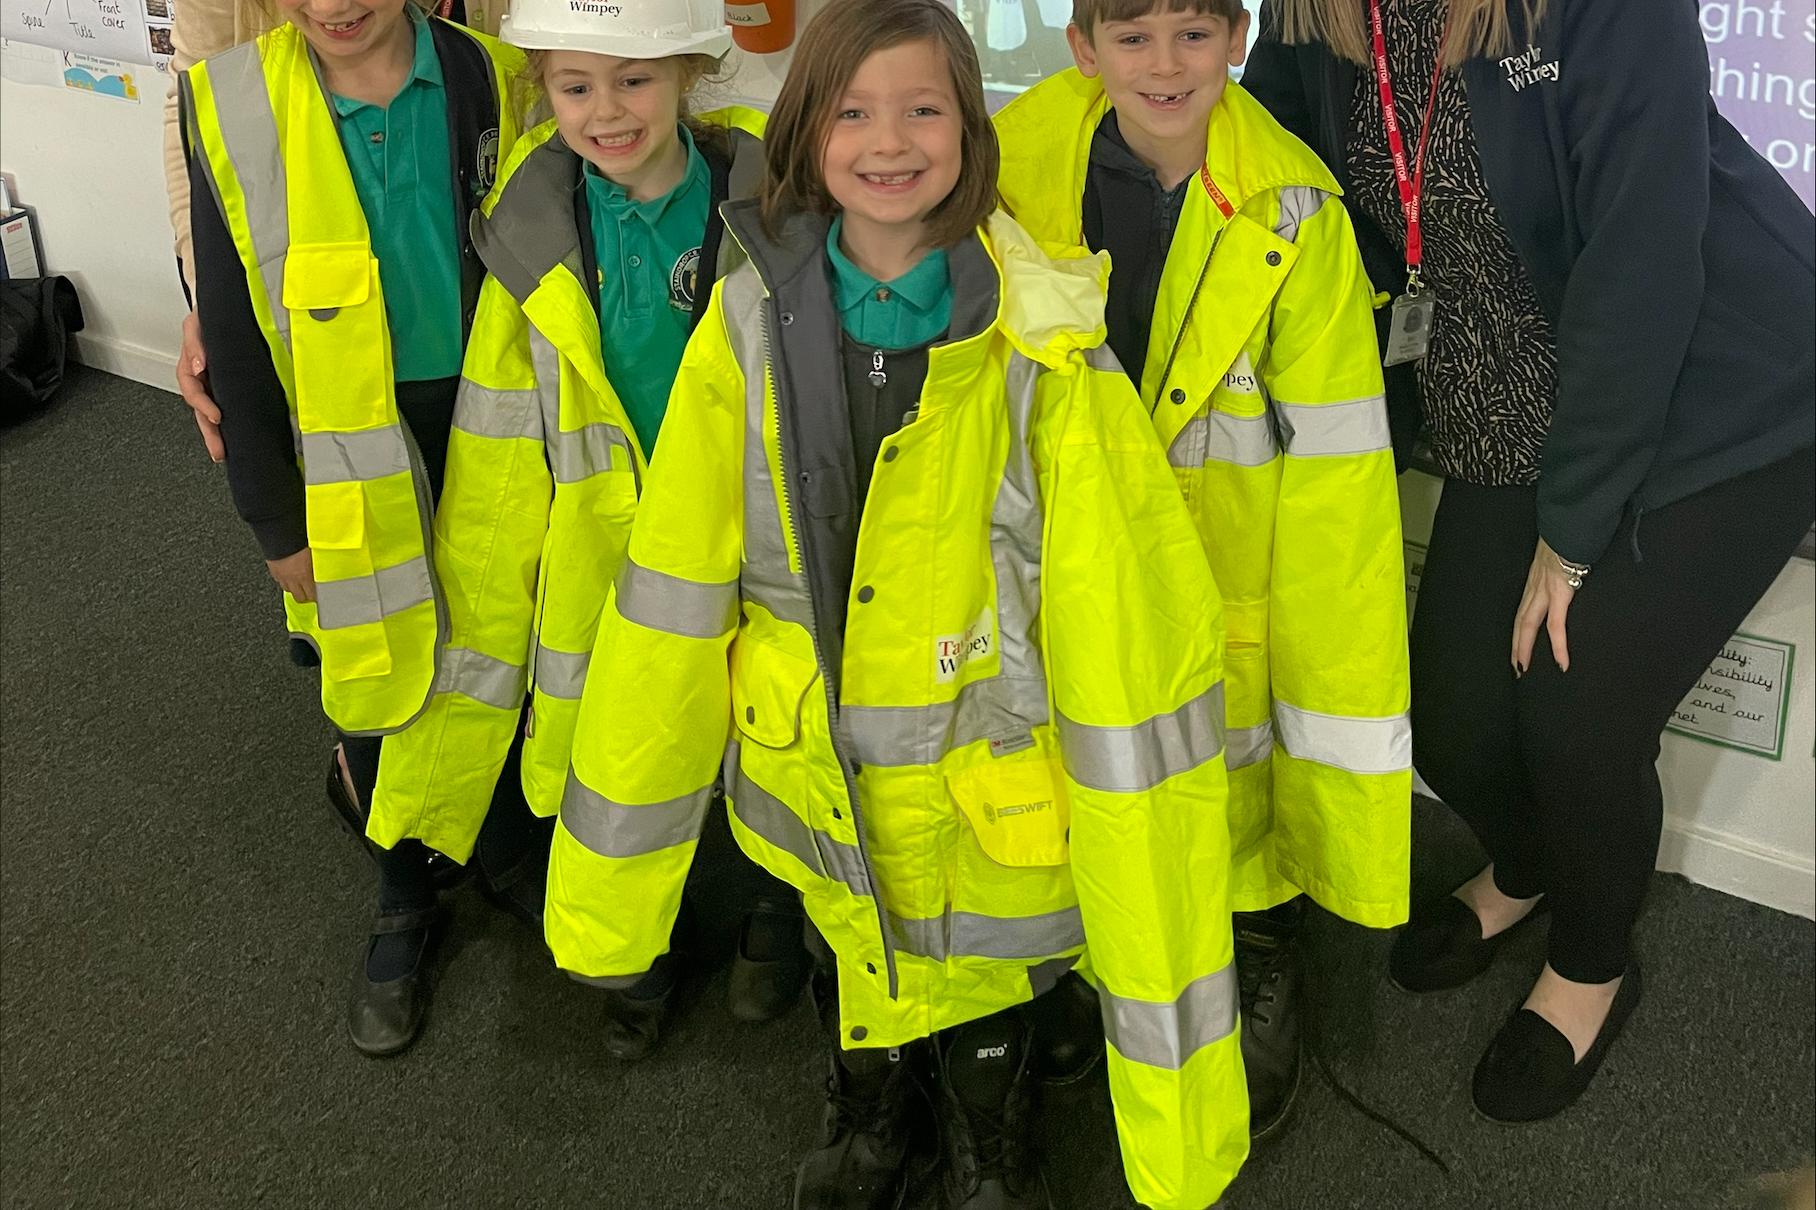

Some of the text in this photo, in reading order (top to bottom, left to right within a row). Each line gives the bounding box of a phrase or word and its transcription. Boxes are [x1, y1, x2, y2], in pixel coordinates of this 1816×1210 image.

[98, 0, 121, 15] Front
[569, 0, 623, 18] Wimpey
[1373, 5, 1383, 36] VISITOR
[1378, 54, 1389, 85] VISITOR
[1384, 103, 1397, 133] VISITOR
[1394, 151, 1408, 182] VISITOR
[1410, 194, 1419, 223] VISITOR
[1690, 699, 1764, 722] and our
[977, 1046, 1005, 1059] arco
